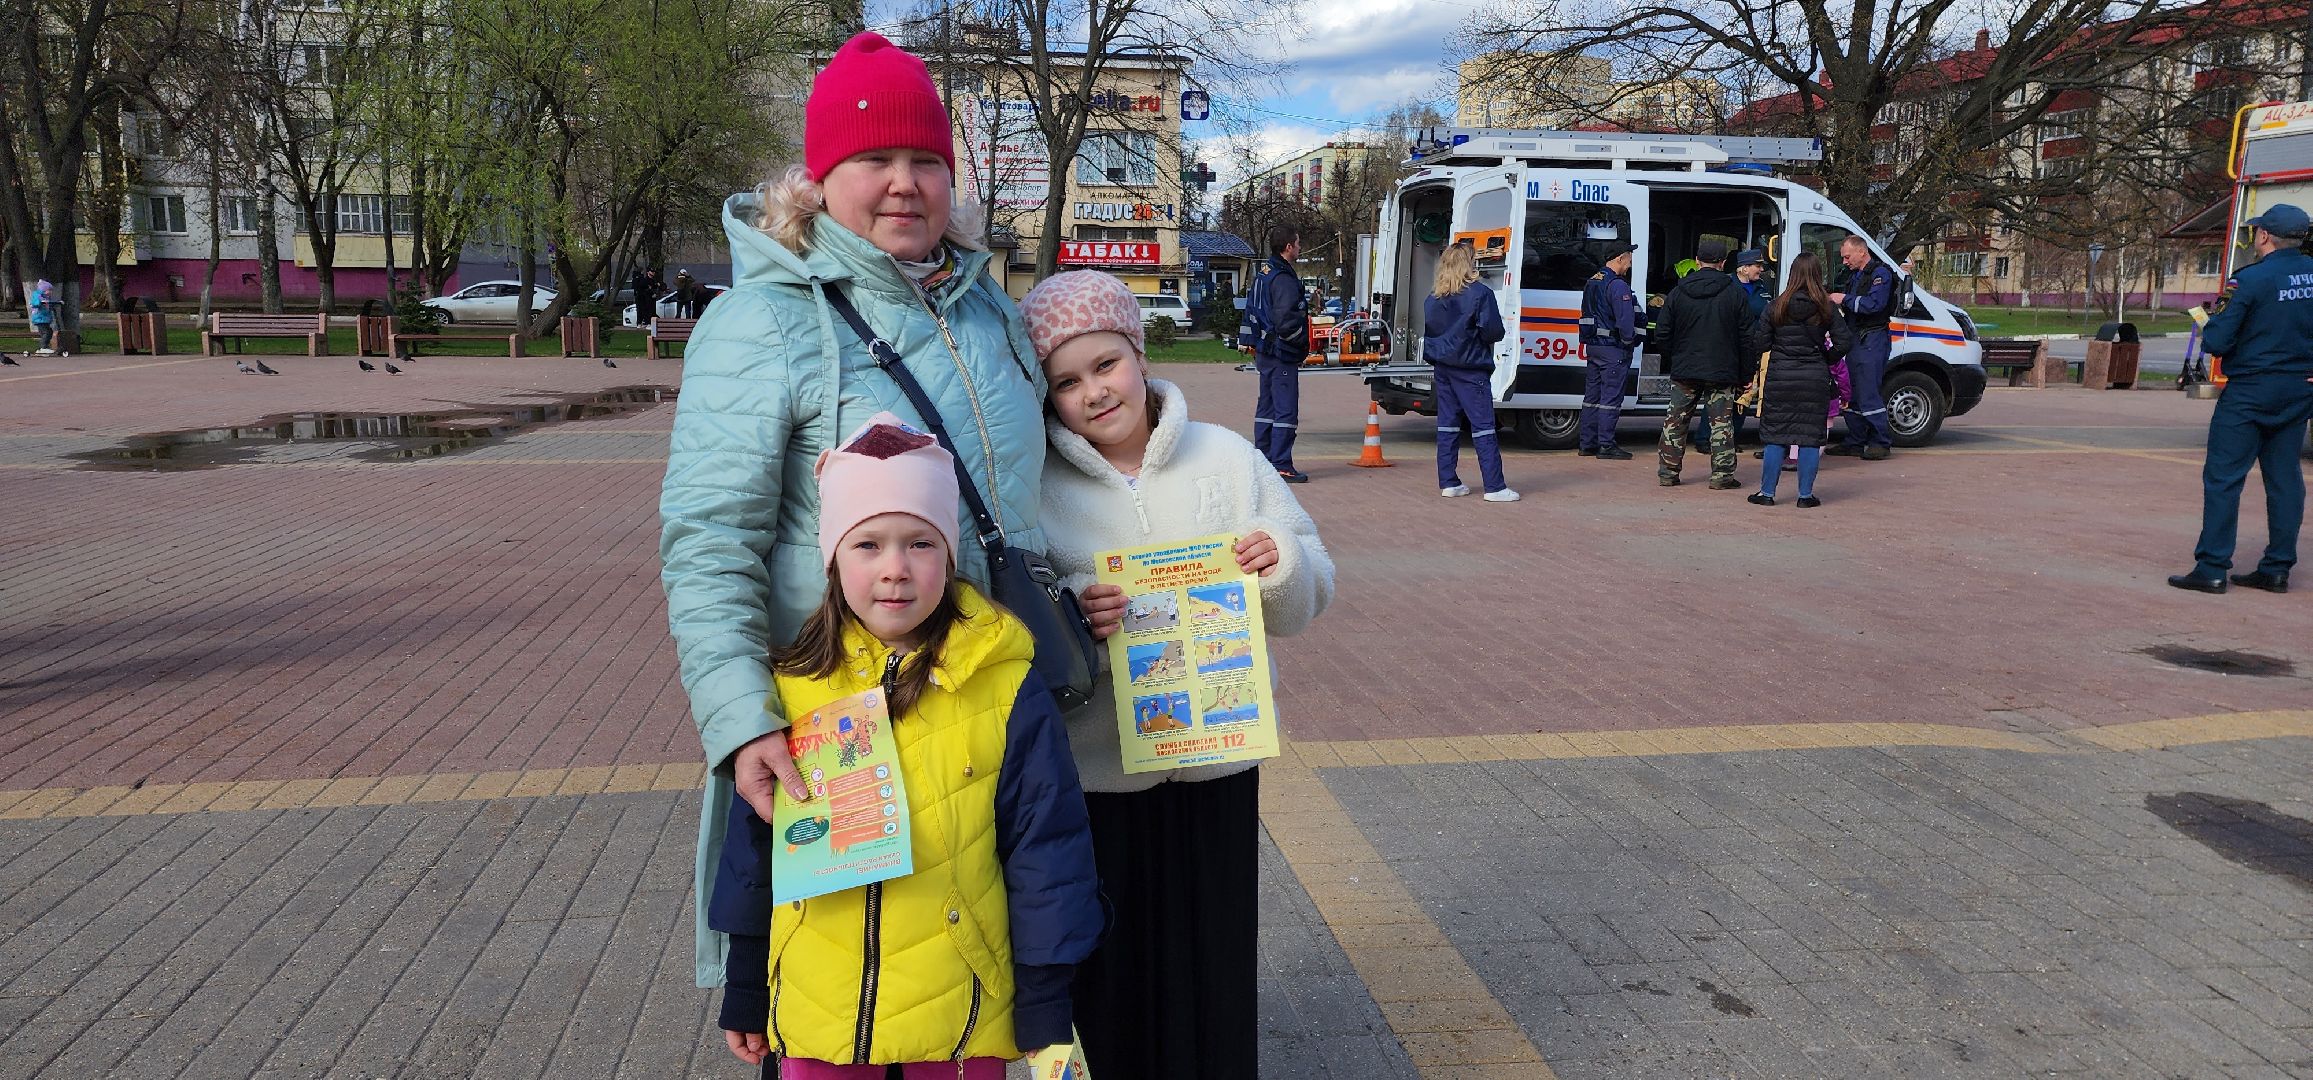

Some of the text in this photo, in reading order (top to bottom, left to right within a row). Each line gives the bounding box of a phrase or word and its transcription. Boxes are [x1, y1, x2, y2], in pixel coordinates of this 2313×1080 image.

[1572, 180, 1609, 202] Спас
[1065, 243, 1137, 258] ТАБАК
[1150, 562, 1204, 576] ПРАВИЛА
[1221, 733, 1246, 749] 112
